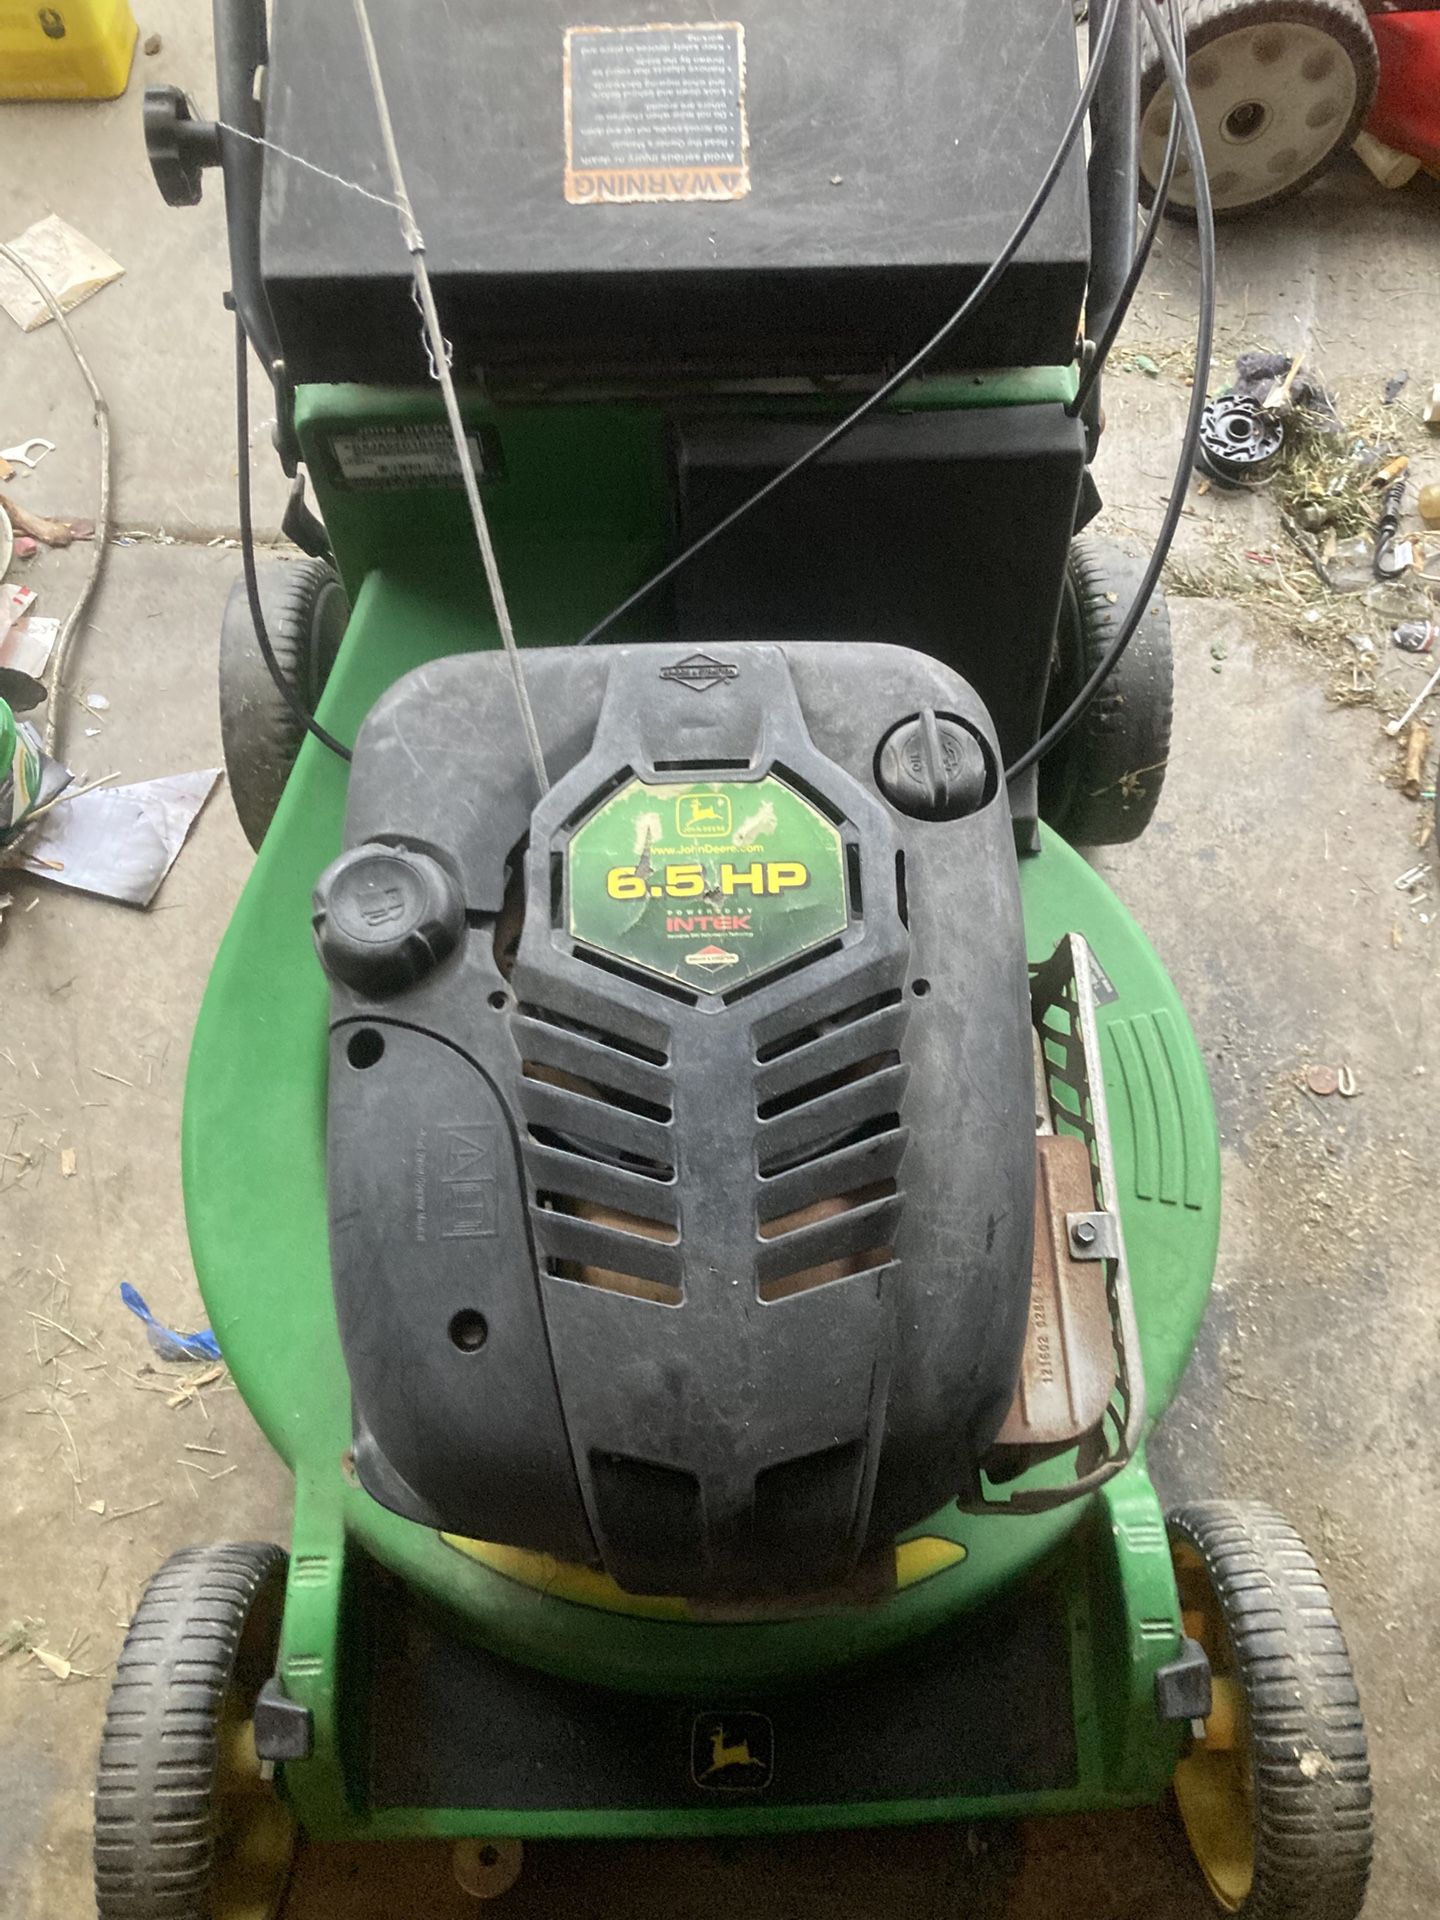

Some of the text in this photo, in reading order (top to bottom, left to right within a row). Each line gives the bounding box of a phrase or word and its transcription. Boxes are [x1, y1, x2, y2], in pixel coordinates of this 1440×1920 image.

[703, 152, 735, 163] Avoid
[575, 174, 716, 196] WARNING
[607, 862, 808, 900] 6.5 HP
[666, 915, 752, 932] INTEK
